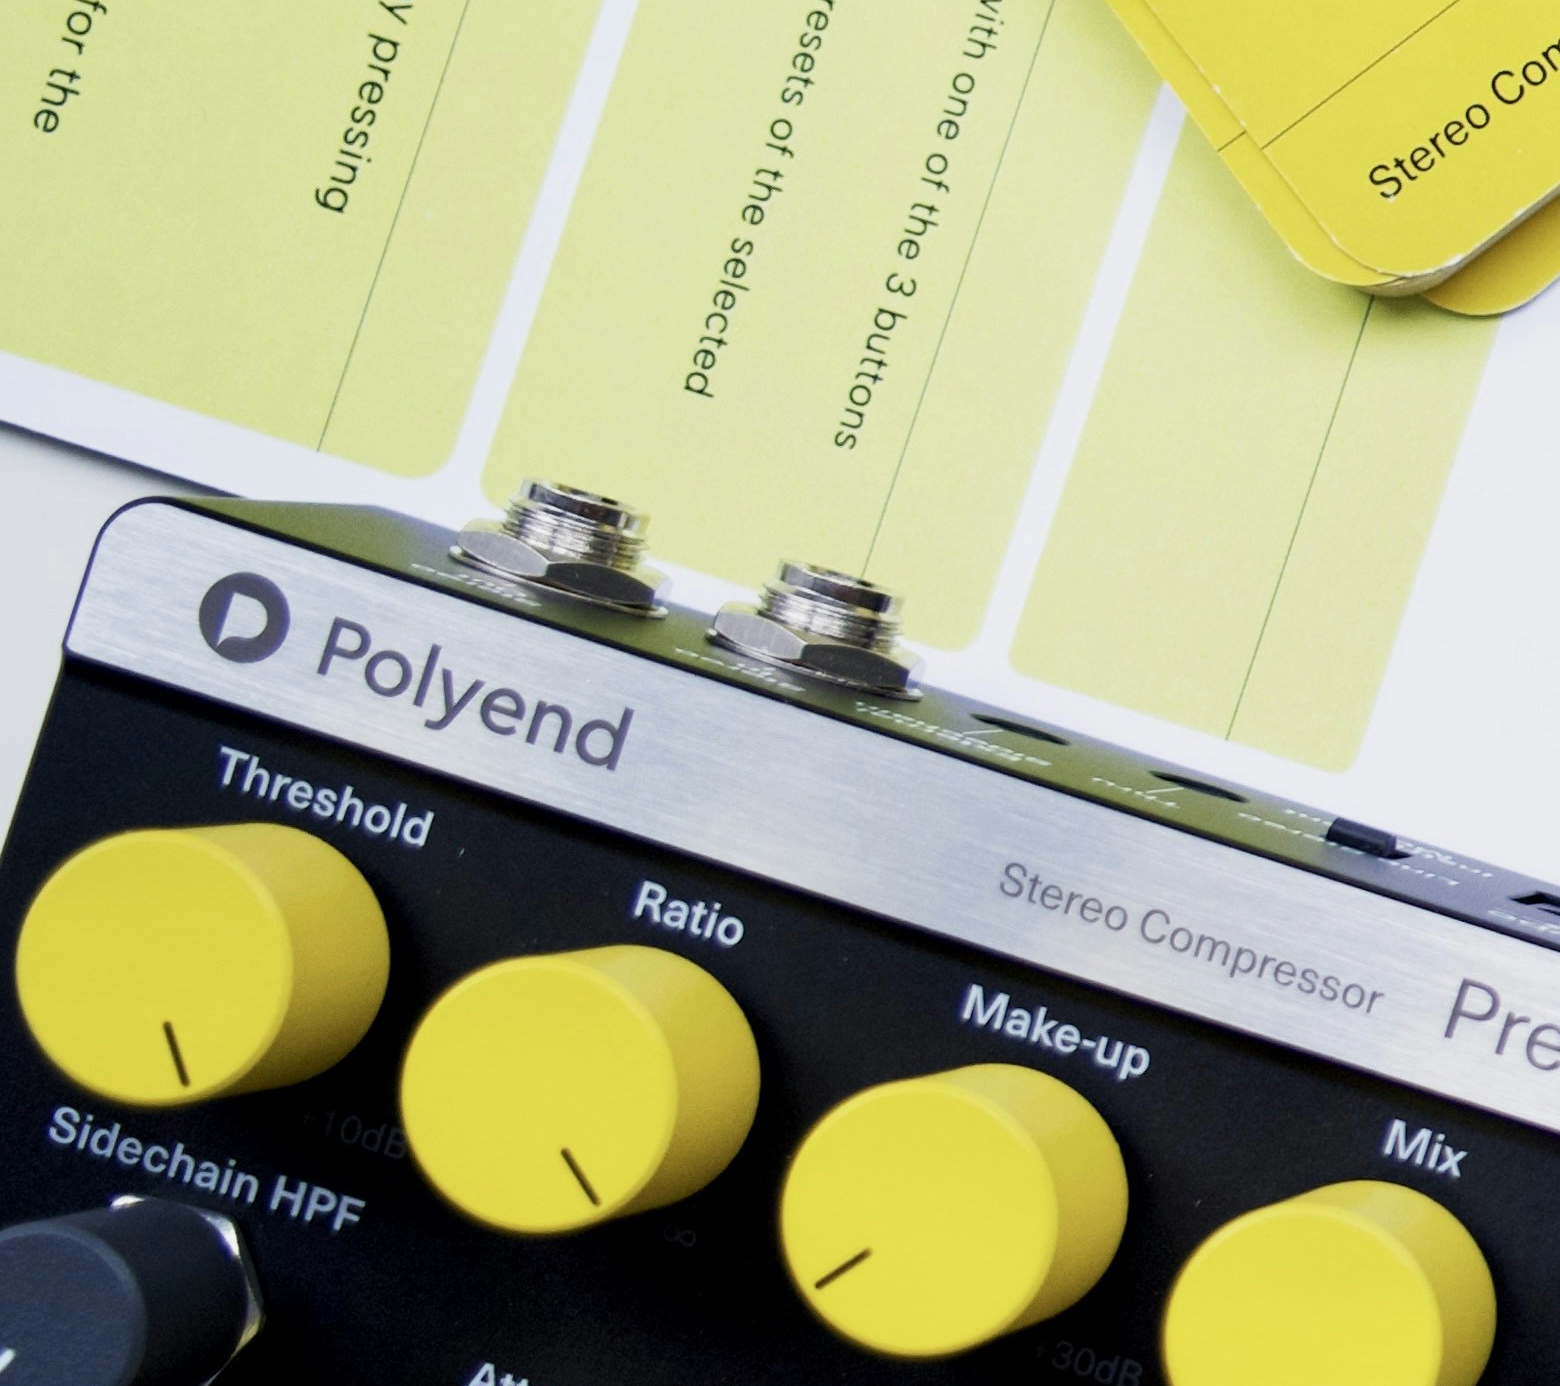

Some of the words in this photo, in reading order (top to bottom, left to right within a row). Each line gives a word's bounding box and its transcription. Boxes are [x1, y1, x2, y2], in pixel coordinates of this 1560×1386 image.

[31, 67, 81, 134] the
[313, 32, 400, 214] pressing
[764, 117, 794, 159] of
[935, 71, 975, 141] one
[920, 152, 950, 193] of
[1368, 102, 1491, 199] Stereo
[740, 167, 783, 226] the
[895, 202, 939, 260] the
[682, 237, 754, 399] selected
[884, 272, 917, 298] 3
[832, 306, 907, 450] buttons
[315, 616, 635, 772] Polyend
[219, 745, 435, 848] Threshold
[632, 880, 744, 947] Ratio
[997, 861, 1128, 932] Stereo
[1139, 908, 1384, 1014] Compressor
[960, 983, 1150, 1081] Make-up
[47, 1105, 259, 1204] Sidechain
[269, 1174, 366, 1231] HPF
[1382, 1118, 1467, 1178] Mix
